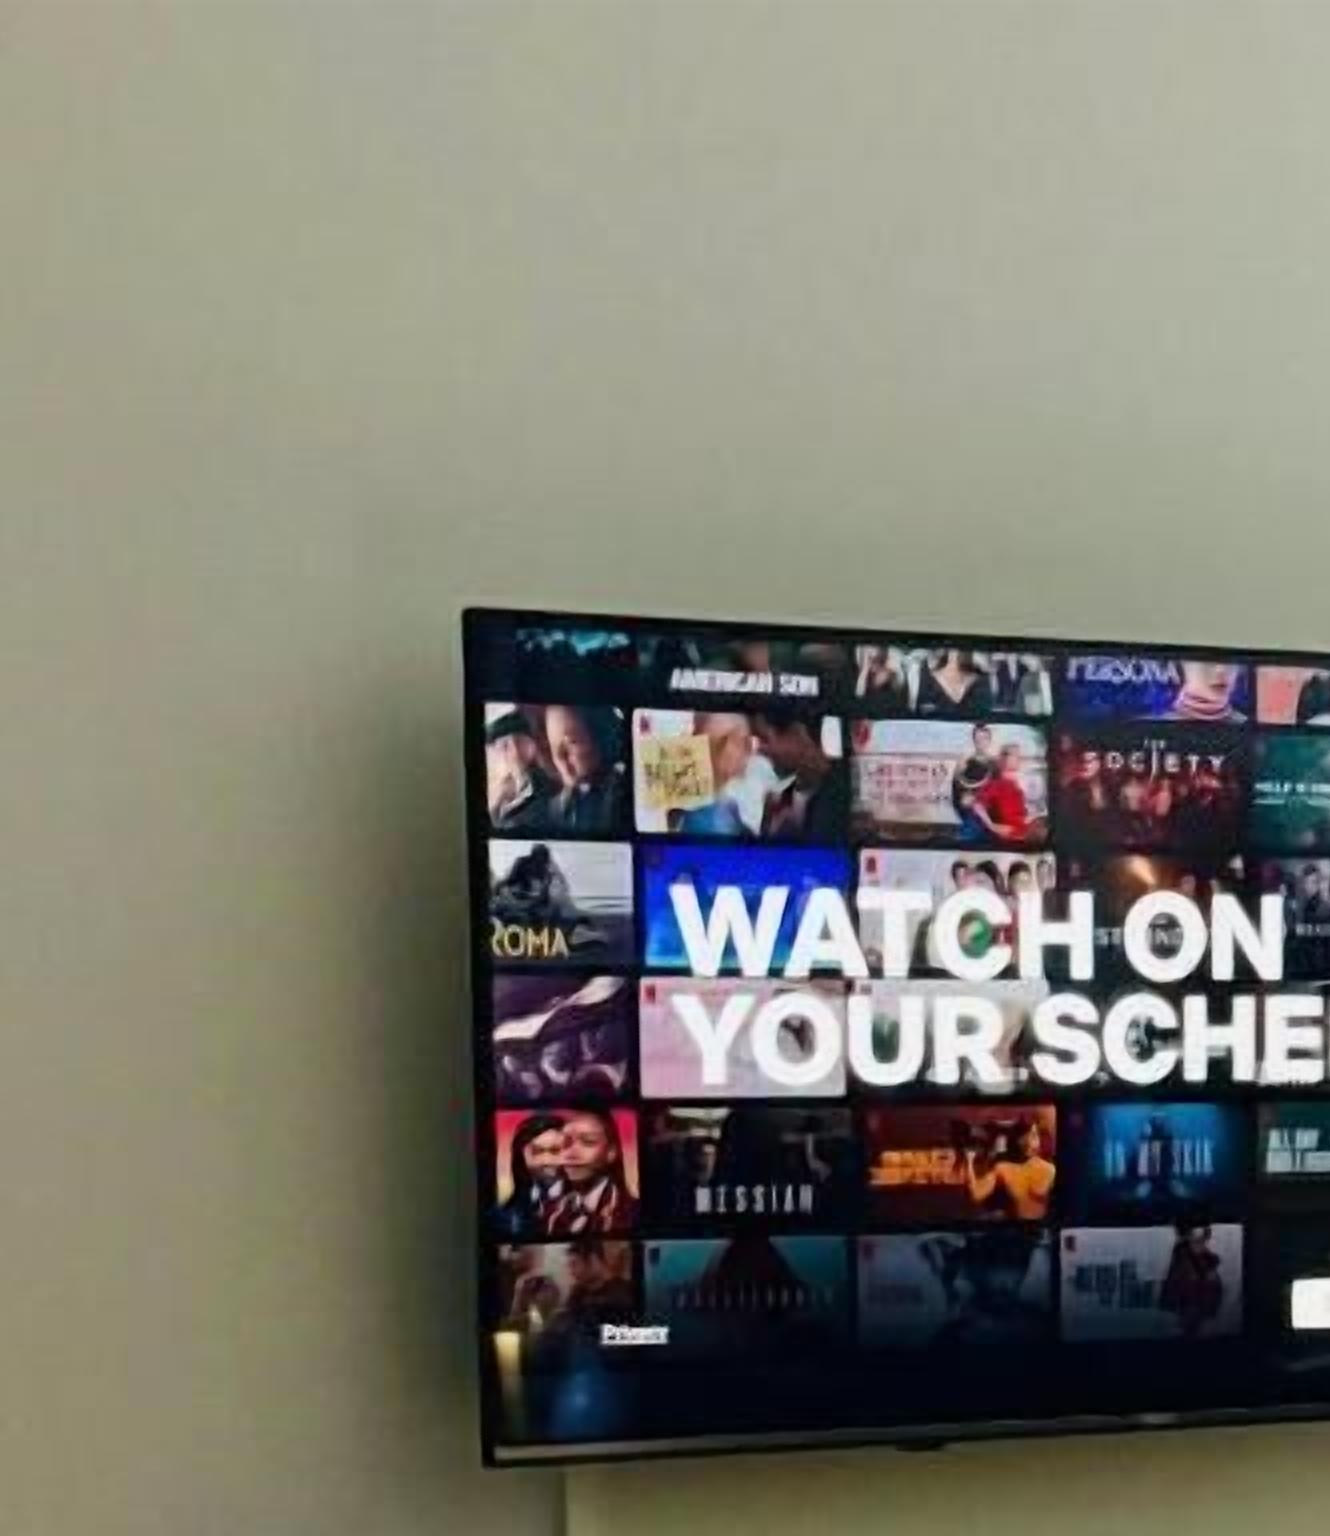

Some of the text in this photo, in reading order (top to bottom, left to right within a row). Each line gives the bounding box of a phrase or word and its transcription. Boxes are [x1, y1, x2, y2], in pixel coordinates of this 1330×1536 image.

[668, 882, 1285, 984] WATCH ON
[671, 991, 1007, 1087] YOUR
